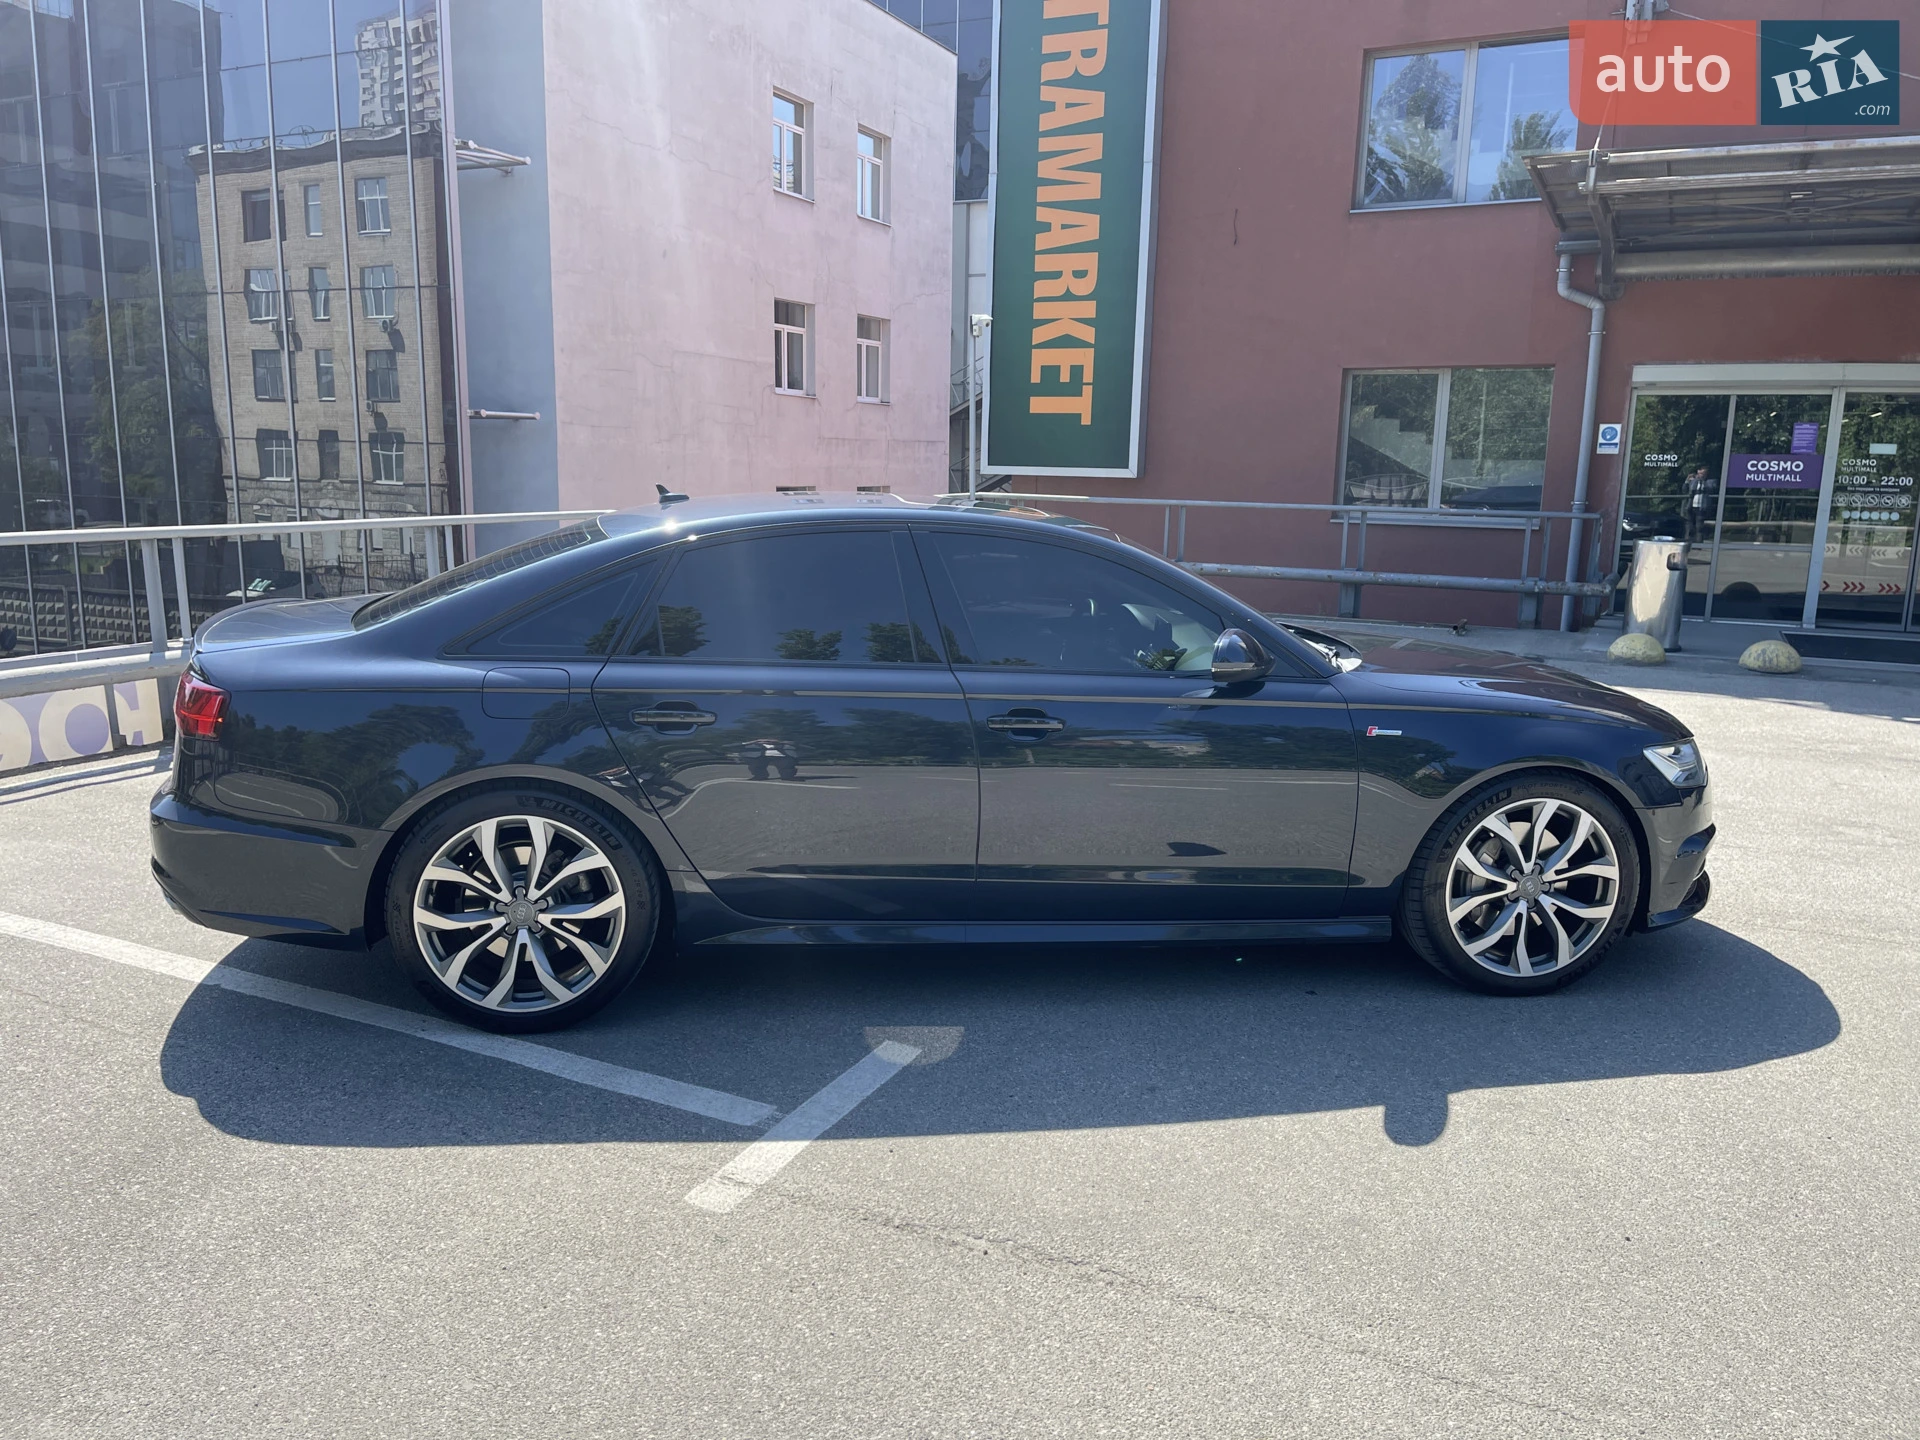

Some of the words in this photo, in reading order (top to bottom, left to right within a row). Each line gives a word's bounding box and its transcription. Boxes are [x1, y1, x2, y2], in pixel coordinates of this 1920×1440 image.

[1644, 453, 1678, 462] COSMO
[1841, 458, 1877, 467] COSMO
[1747, 460, 1804, 472] COSMO
[1745, 473, 1802, 482] MULTIMALL
[1837, 475, 1867, 485] 10:00
[1880, 476, 1913, 486] 22:00
[1447, 788, 1509, 846] MICHELIN
[541, 799, 620, 850] MICHELIN
